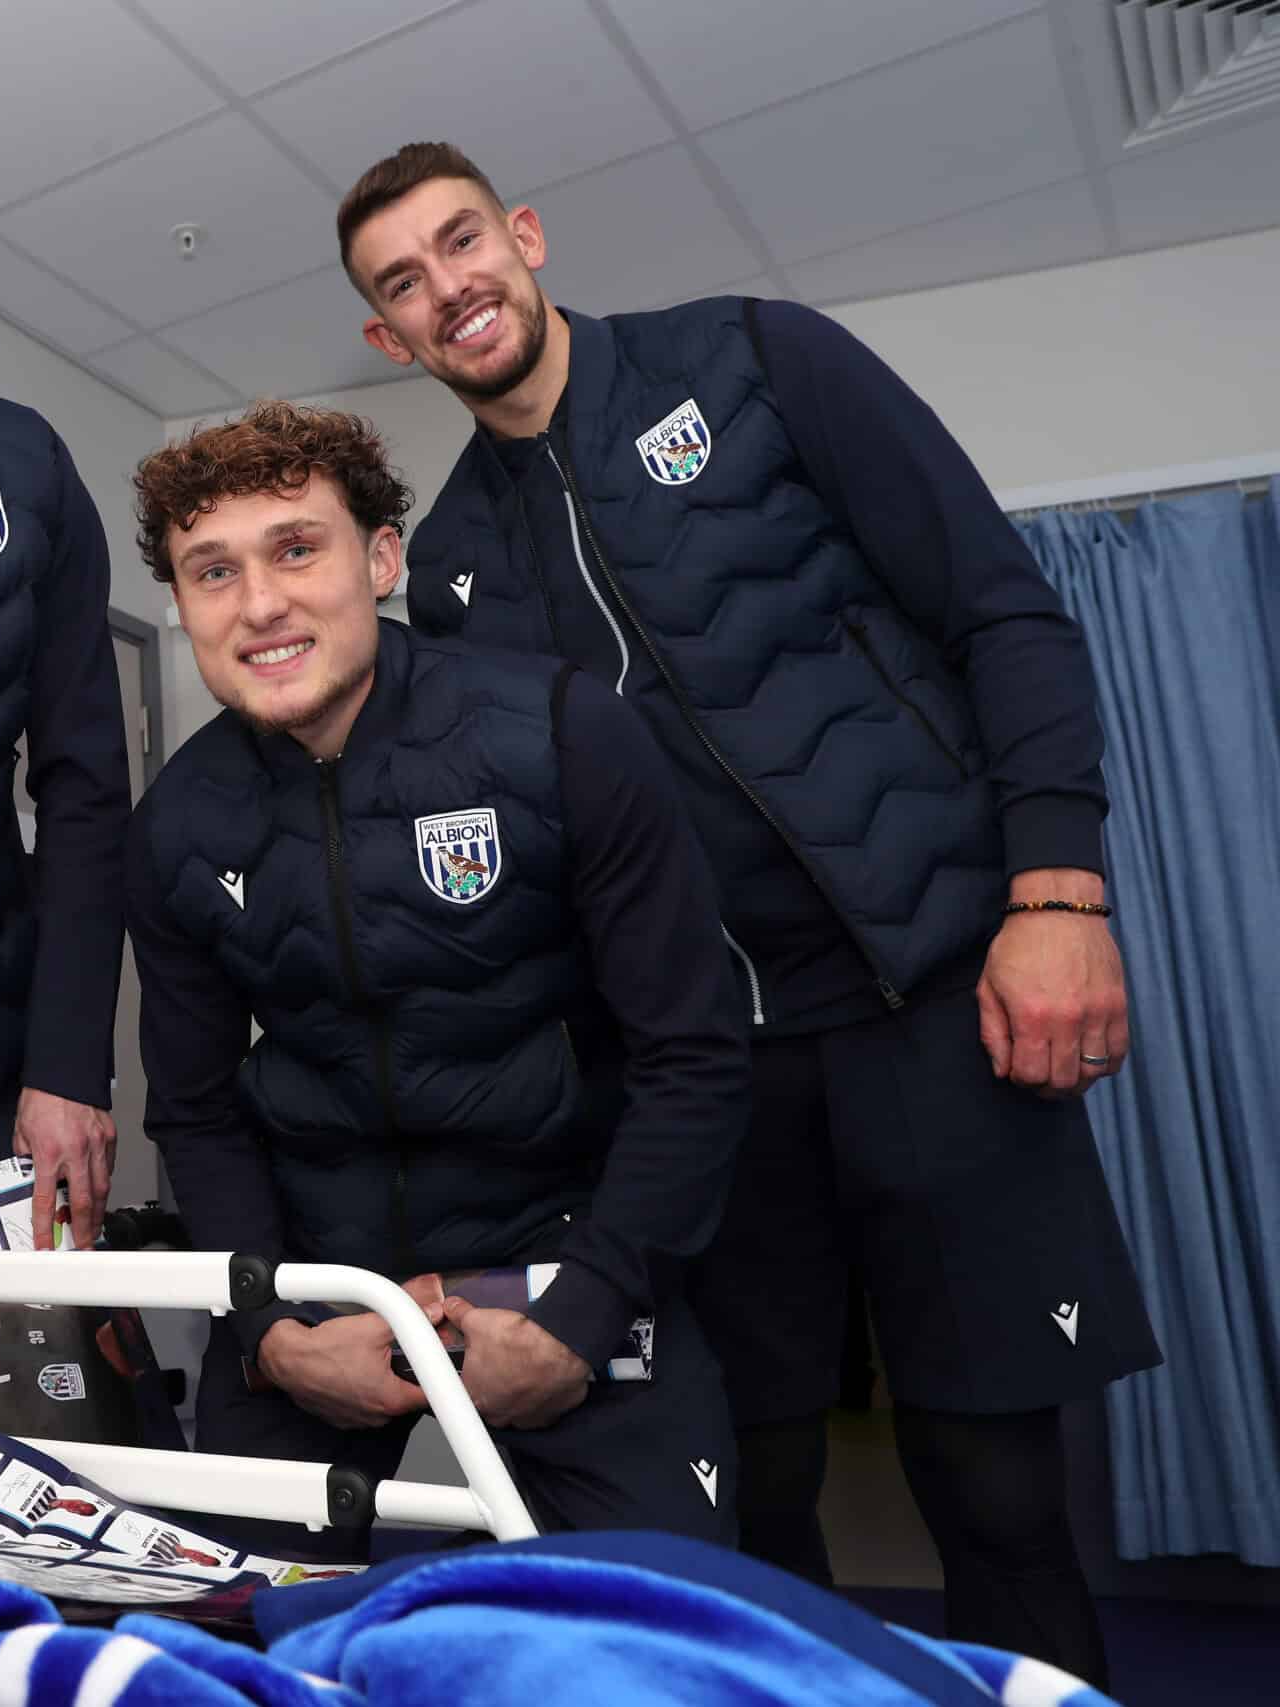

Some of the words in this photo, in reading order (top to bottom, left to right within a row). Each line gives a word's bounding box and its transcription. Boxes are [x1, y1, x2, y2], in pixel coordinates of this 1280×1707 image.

[646, 412, 694, 452] ALBION
[423, 822, 443, 831] WEST
[446, 816, 488, 828] BROMWICH
[425, 824, 490, 845] ALBION
[28, 1330, 46, 1345] CC
